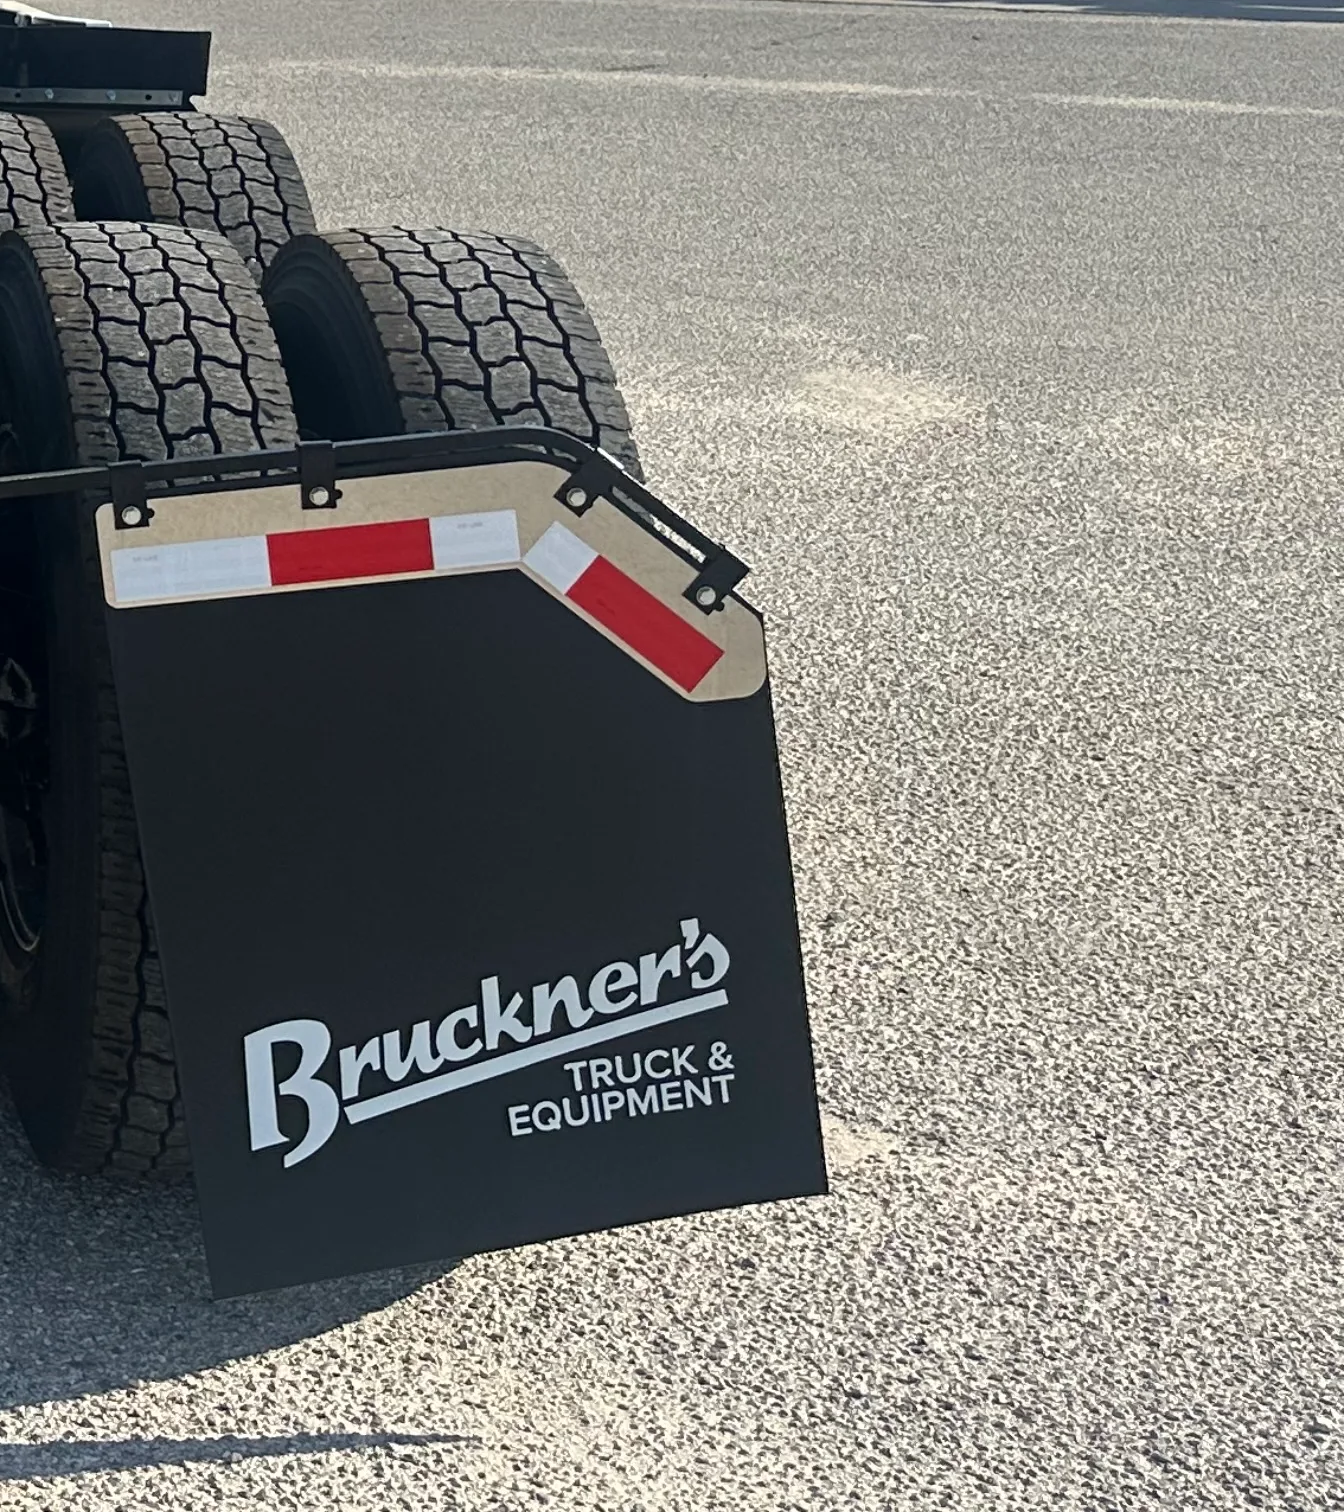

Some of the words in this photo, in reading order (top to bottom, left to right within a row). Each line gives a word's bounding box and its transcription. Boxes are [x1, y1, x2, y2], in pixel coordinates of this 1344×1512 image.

[244, 918, 731, 1168] Bruckner's
[564, 1045, 698, 1092] TRUCK
[707, 1041, 735, 1071] &
[508, 1074, 735, 1137] EQUIPMENT
